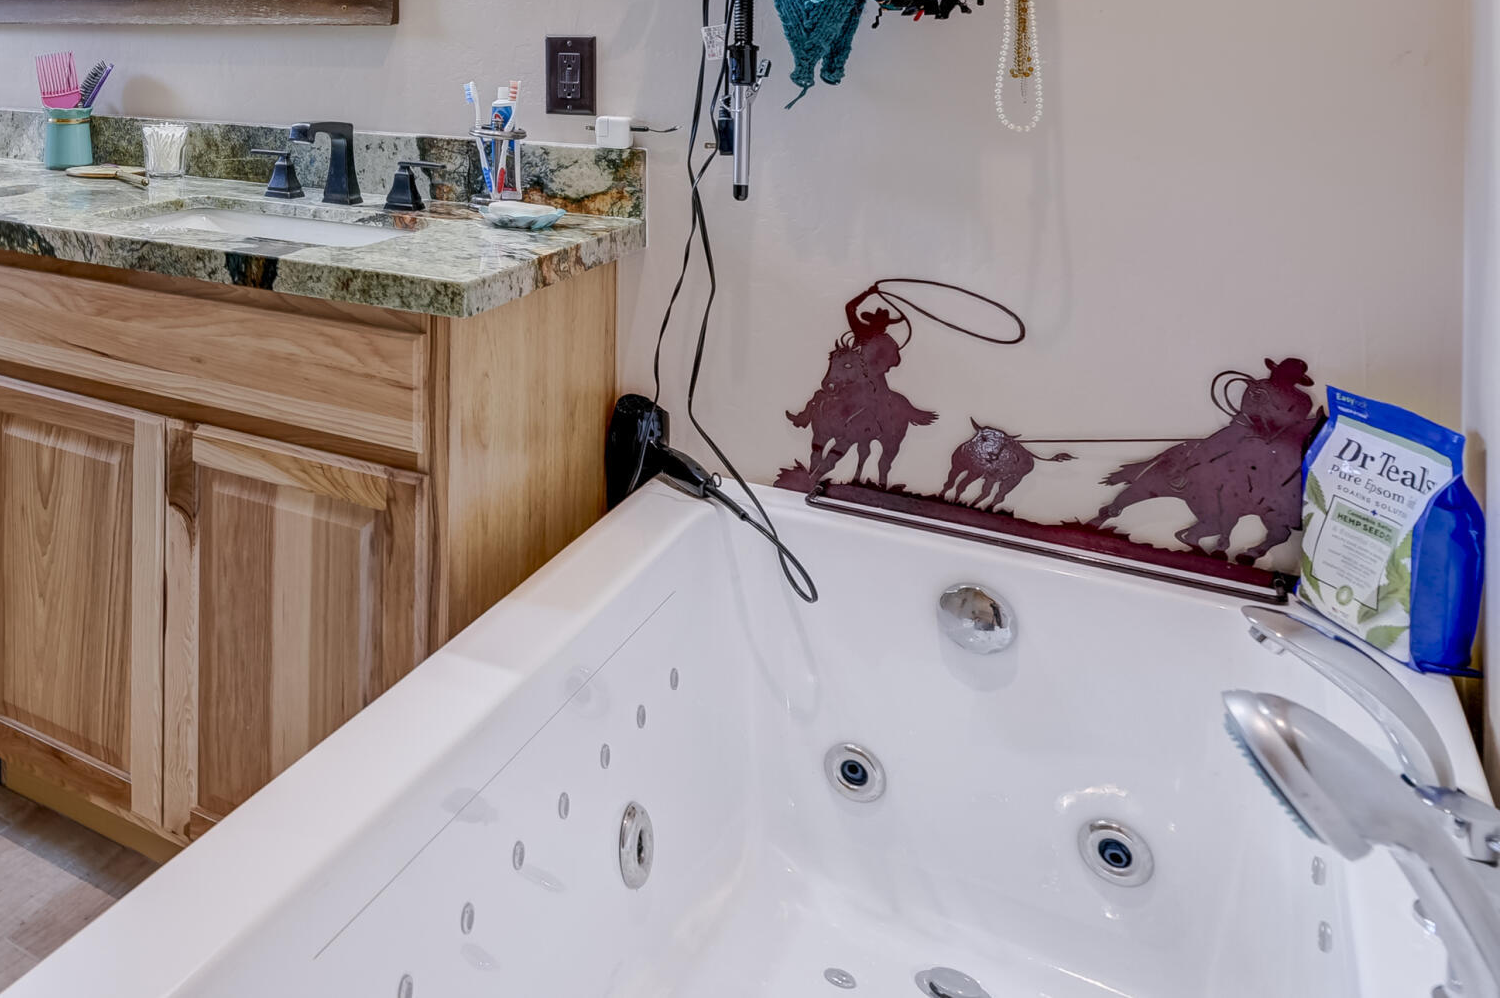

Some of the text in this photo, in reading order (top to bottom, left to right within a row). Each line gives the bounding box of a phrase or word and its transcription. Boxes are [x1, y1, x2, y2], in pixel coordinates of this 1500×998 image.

[1333, 437, 1375, 470] Dr
[1329, 464, 1362, 486] Pure
[1364, 479, 1405, 505] Epsom
[1336, 512, 1362, 527] HEMP
